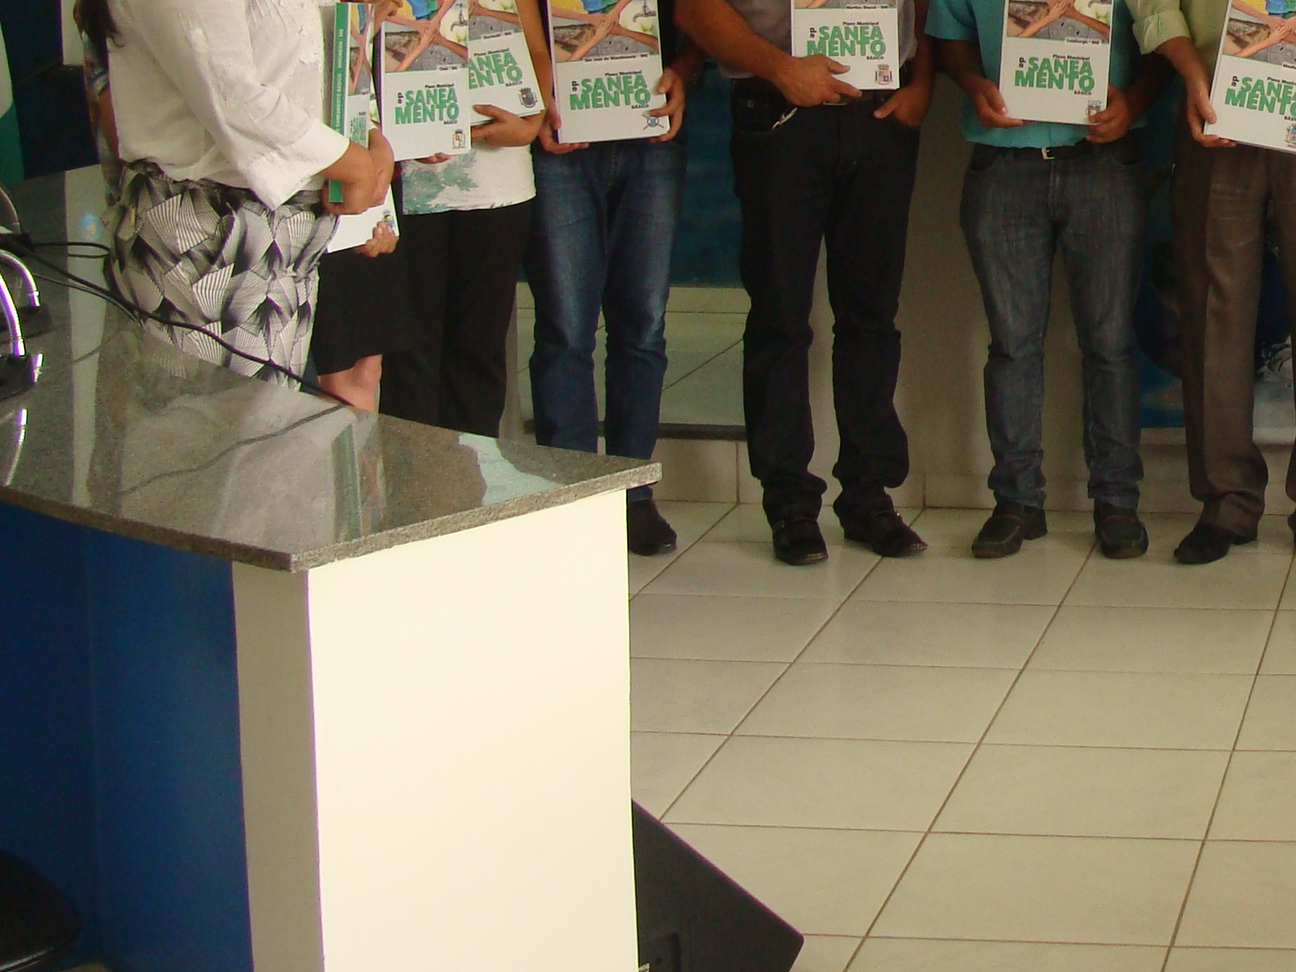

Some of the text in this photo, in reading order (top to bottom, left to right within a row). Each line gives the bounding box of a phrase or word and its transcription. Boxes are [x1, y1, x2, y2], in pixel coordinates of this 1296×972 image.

[819, 26, 884, 42] SANEA
[807, 38, 886, 56] MENTO
[469, 52, 518, 71] ANEA
[1028, 56, 1094, 76] SANEA
[469, 66, 522, 90] ENTO
[581, 74, 648, 94] SANEA
[1014, 70, 1095, 92] MENTO
[405, 88, 458, 106] SANEA
[570, 88, 651, 110] MENTO
[394, 103, 460, 125] MENTO
